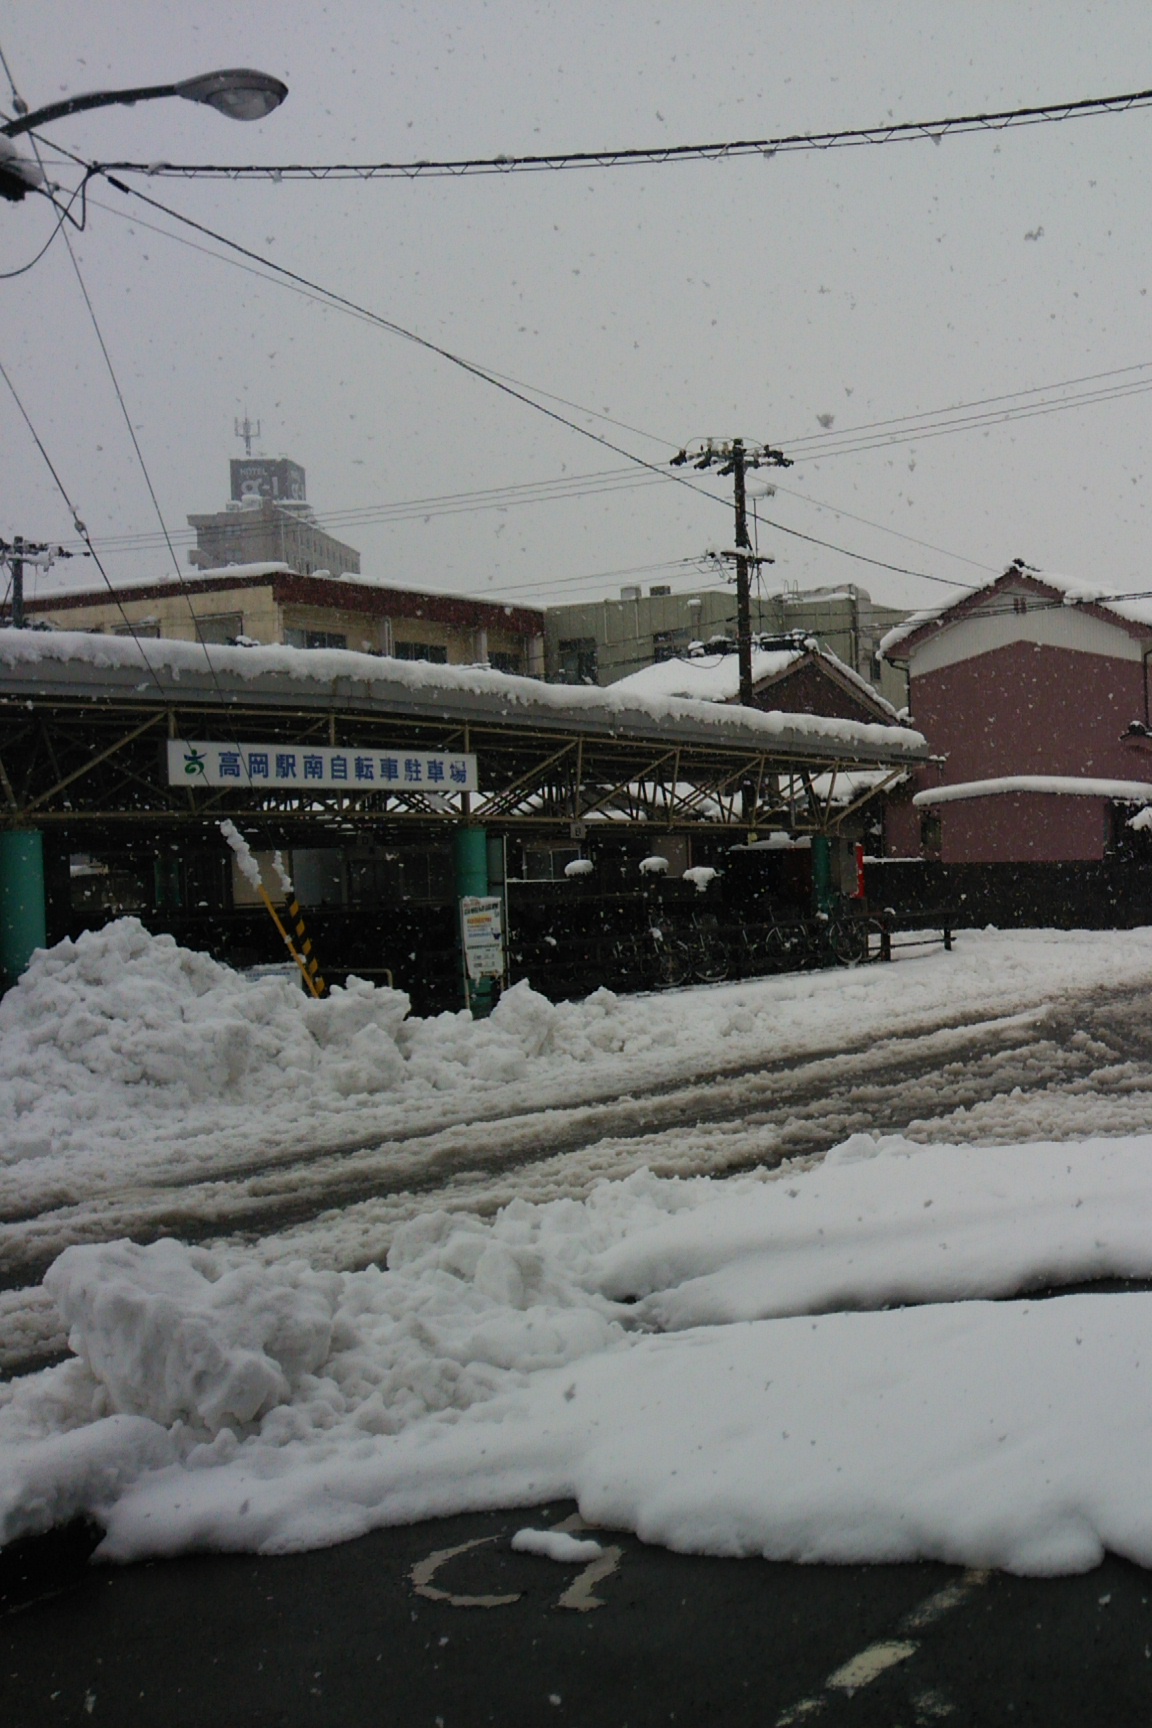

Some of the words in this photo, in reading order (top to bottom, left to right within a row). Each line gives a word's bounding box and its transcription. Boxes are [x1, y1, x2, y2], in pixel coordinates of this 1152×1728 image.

[217, 750, 468, 784] 高岡駅南自転車駐車場
